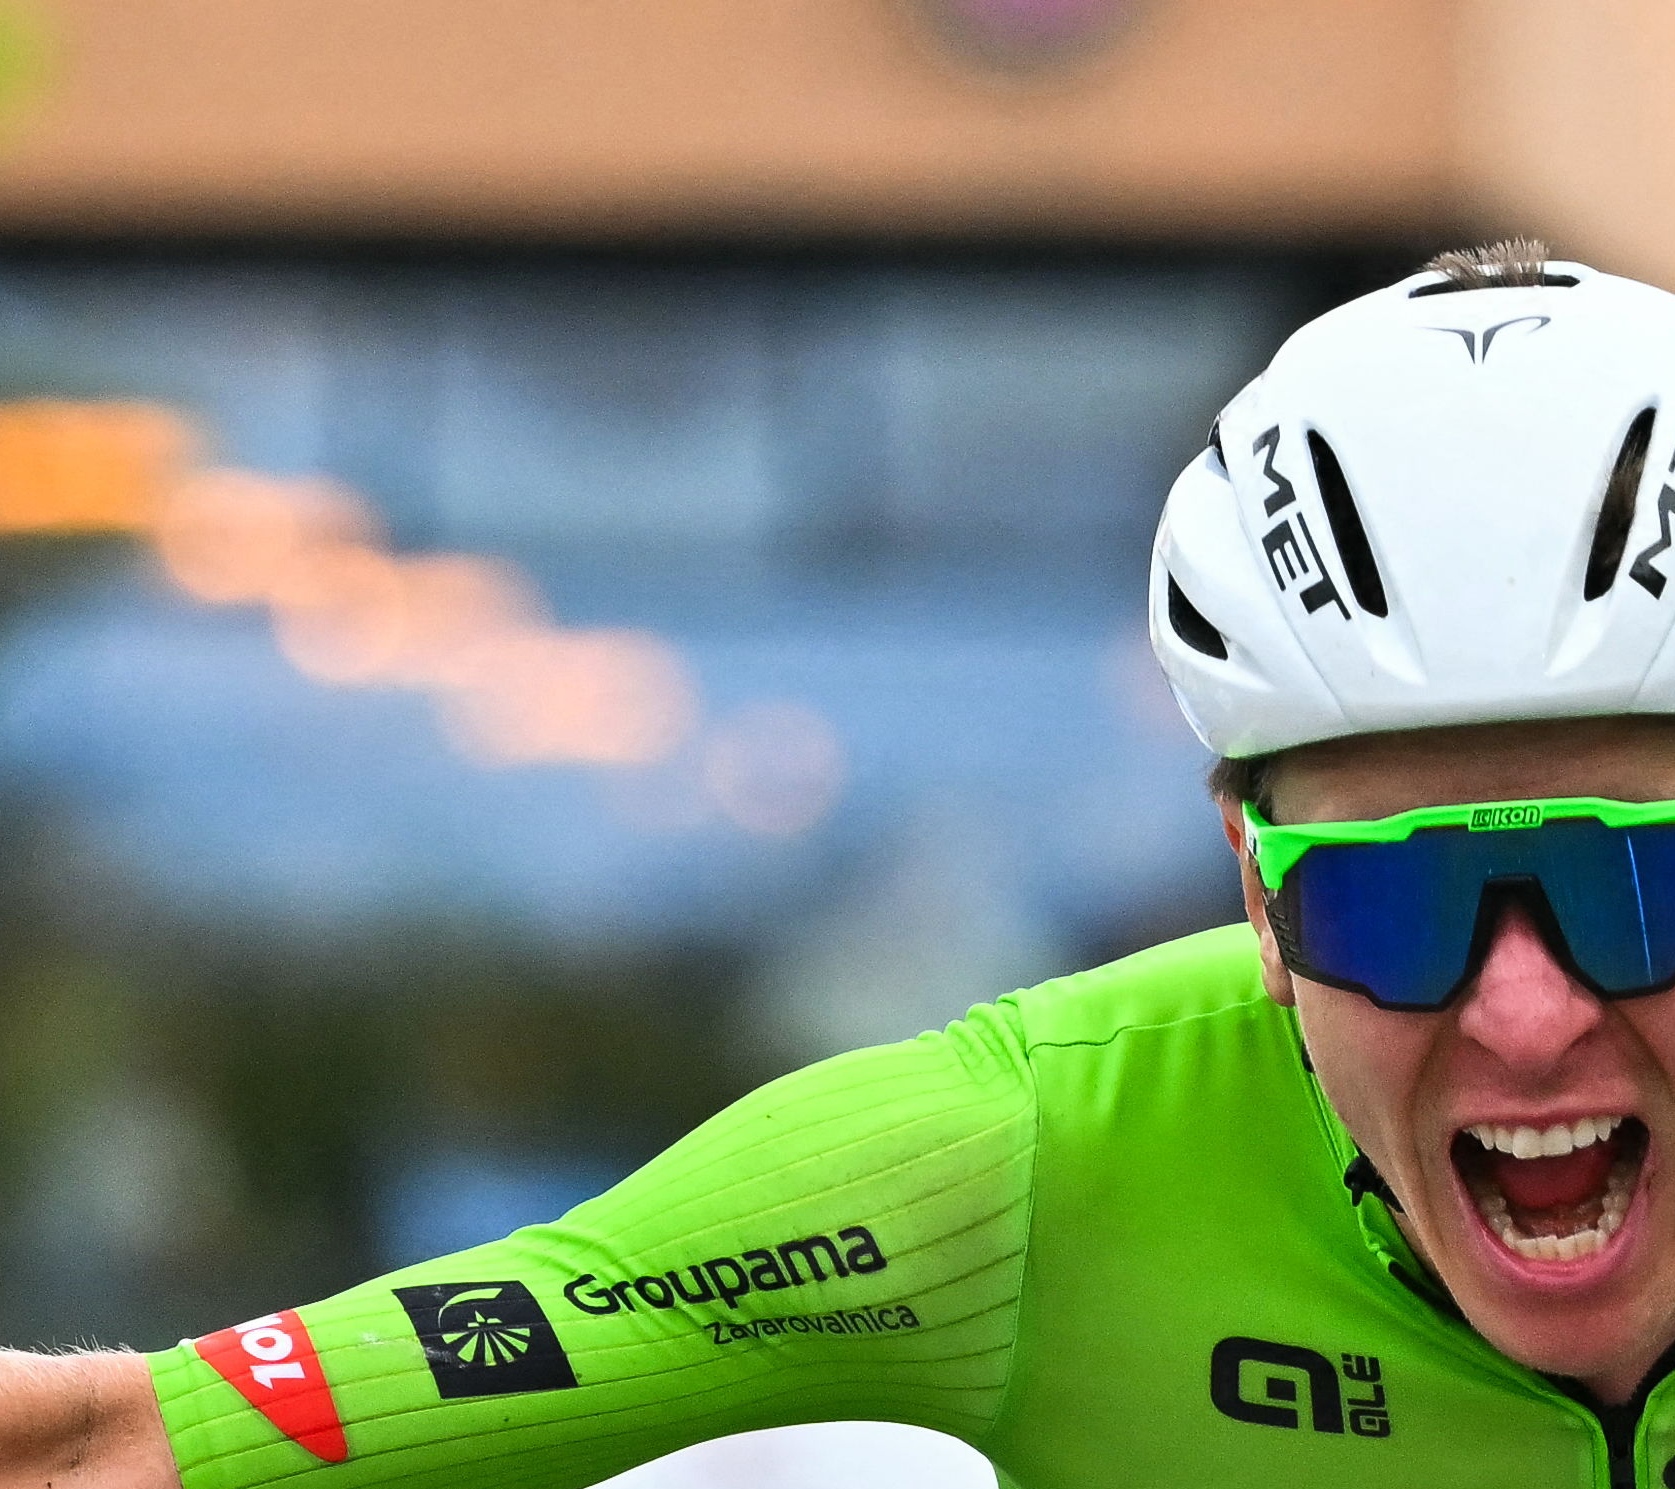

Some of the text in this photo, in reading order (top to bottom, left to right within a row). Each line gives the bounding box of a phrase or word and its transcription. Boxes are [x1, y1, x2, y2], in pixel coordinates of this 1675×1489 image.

[1252, 425, 1351, 621] MET
[563, 1226, 888, 1315] Groupama
[704, 1304, 920, 1344] Zavarovalnica
